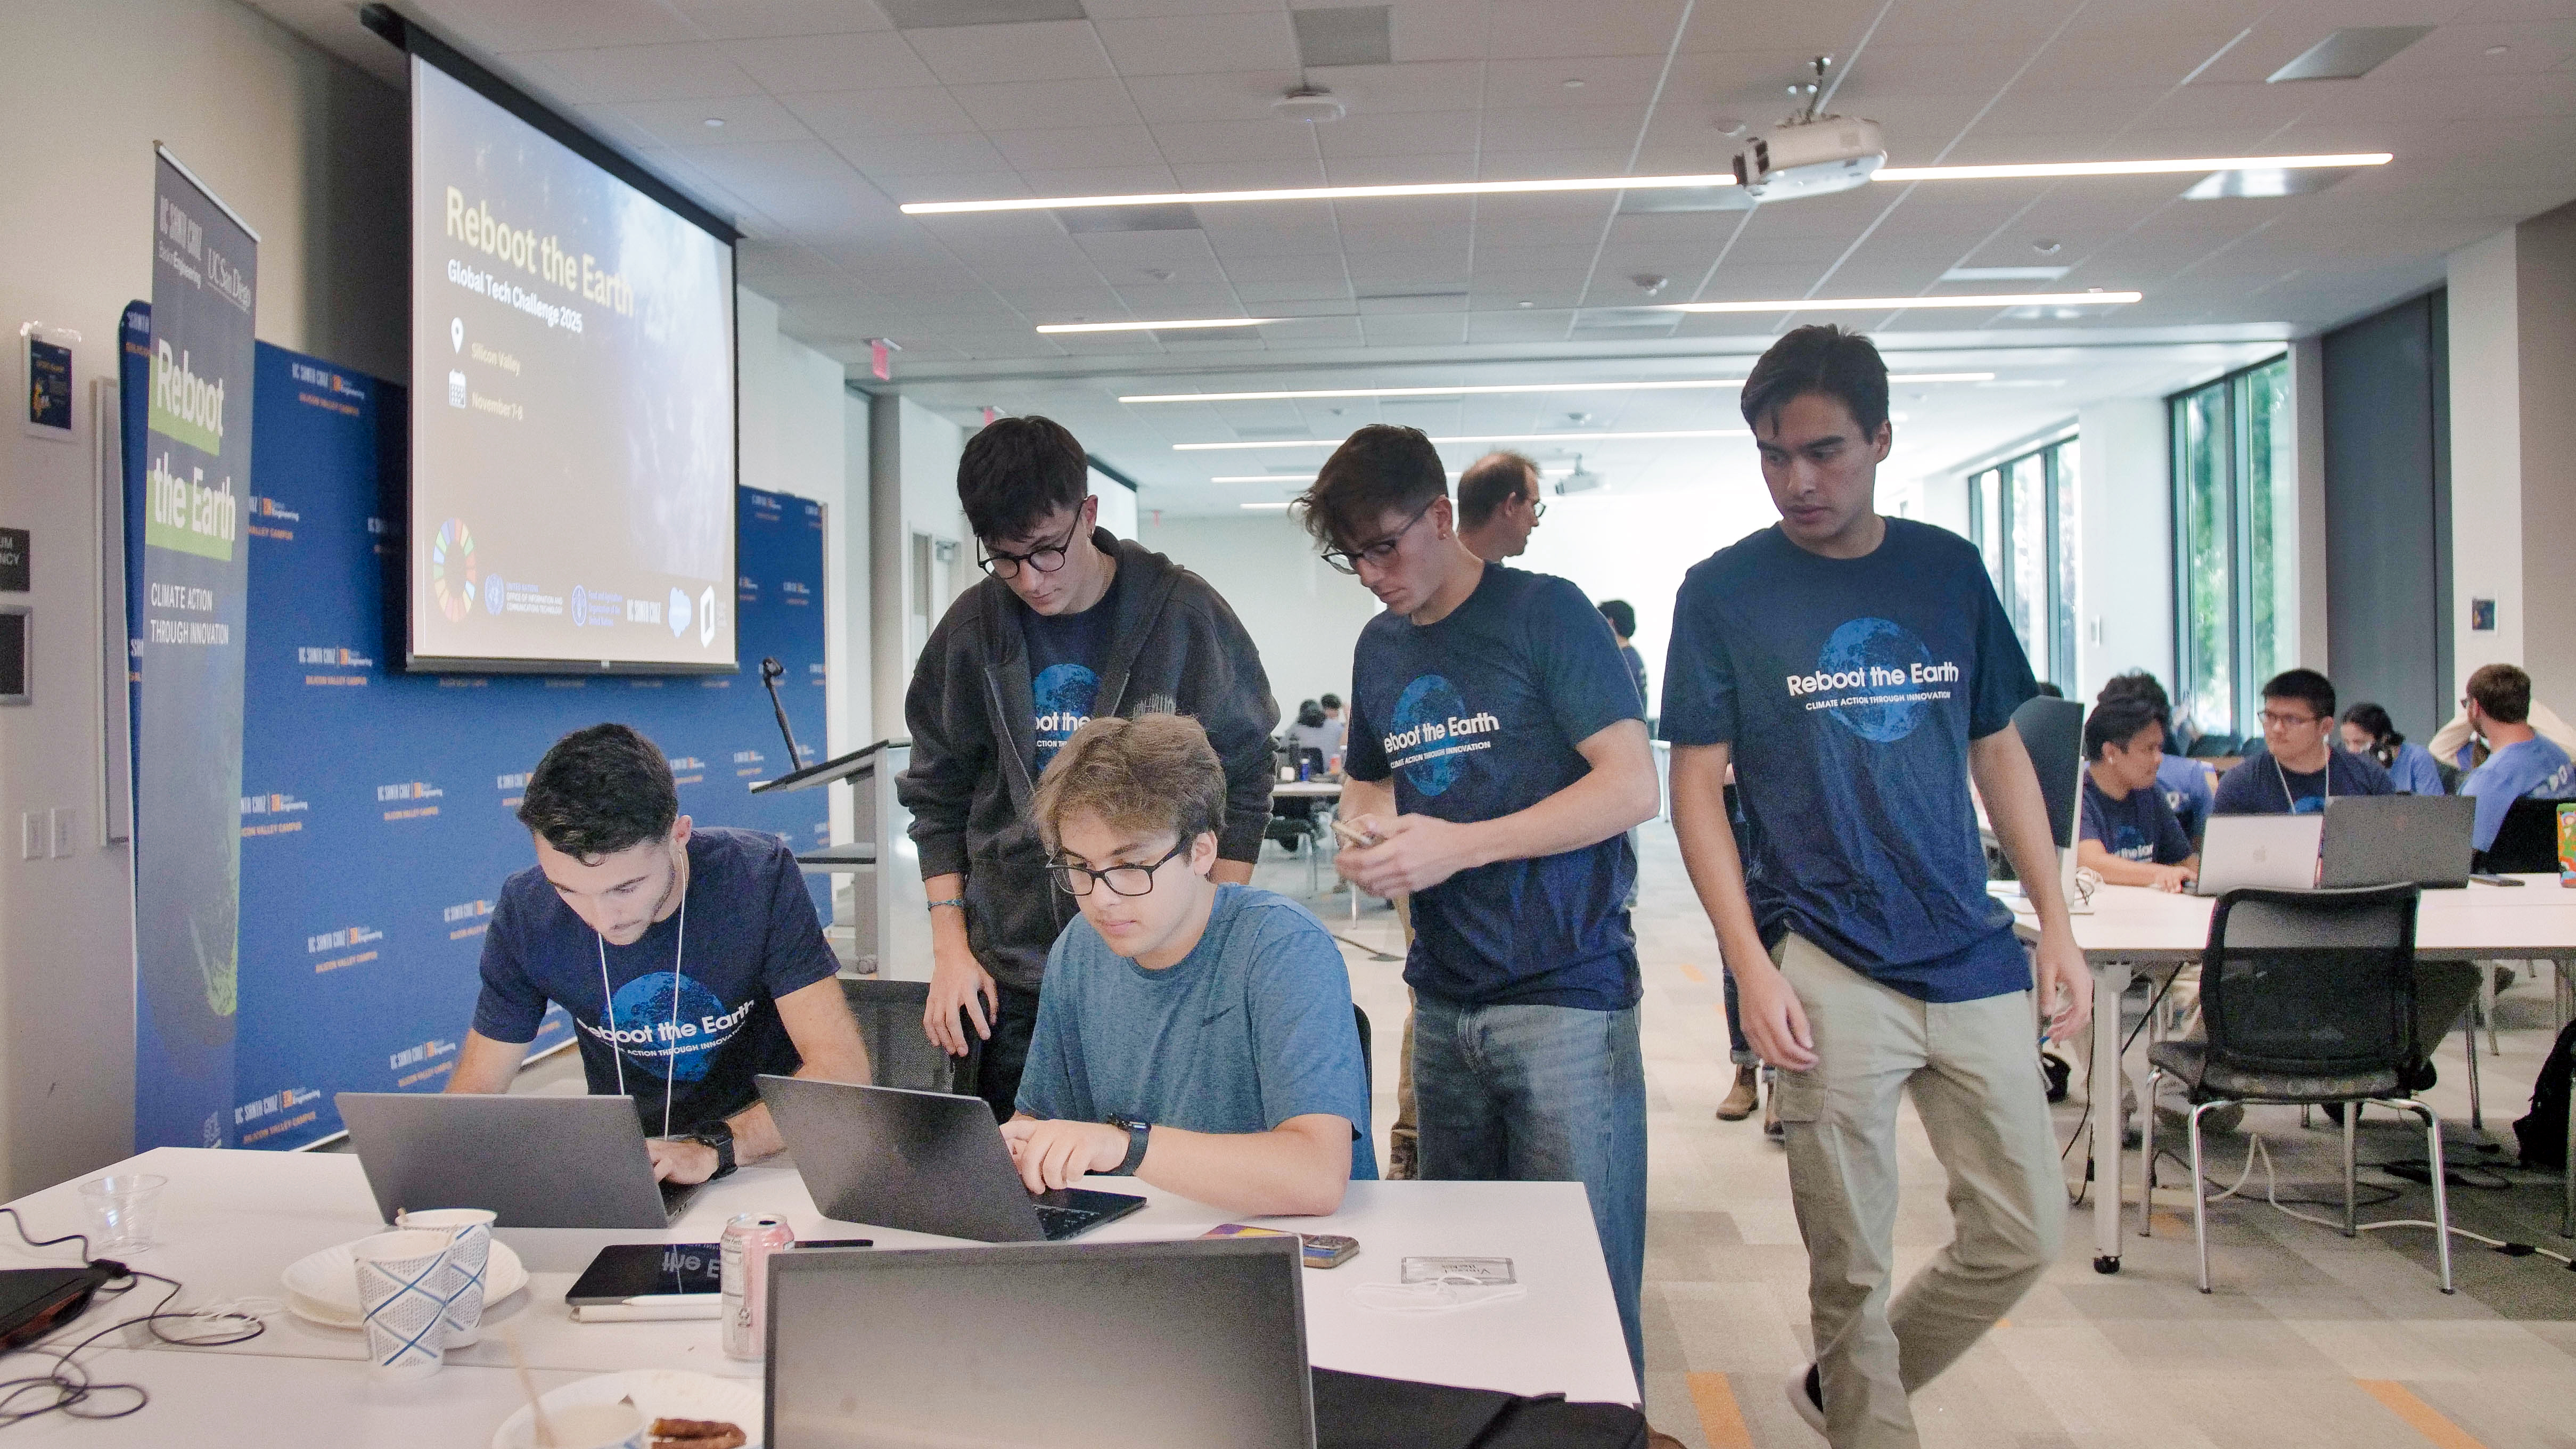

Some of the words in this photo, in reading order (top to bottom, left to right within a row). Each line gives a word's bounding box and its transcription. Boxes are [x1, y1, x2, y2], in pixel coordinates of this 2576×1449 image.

[447, 185, 537, 274] Reboot
[541, 235, 577, 291] the
[583, 253, 634, 317] Earth
[448, 259, 484, 293] Global
[485, 274, 510, 304] Tech
[513, 285, 559, 328] Challenge
[560, 306, 583, 334] 2025
[472, 341, 498, 367] Silicon
[498, 349, 521, 377] Valley
[157, 339, 224, 437] Reboot
[472, 391, 511, 419] November
[154, 451, 186, 528] the
[193, 466, 236, 542] Earth
[151, 582, 186, 609] CLIMATE
[187, 587, 213, 612] ACTION
[150, 619, 189, 644] THROUGH
[190, 621, 229, 645] INNOVATION
[1787, 667, 1865, 697] Reboot
[1871, 666, 1905, 686] the
[1910, 661, 1959, 684] Earth
[1806, 699, 1838, 710] CLIMATE
[1841, 697, 1868, 707] ACTION
[1869, 694, 1905, 704] THROUGH
[1906, 691, 1951, 701] INNOVATION
[1384, 725, 1421, 754] eboot
[1423, 723, 1446, 742] the
[1448, 712, 1500, 737] Earth
[1405, 754, 1424, 764] ACTION
[1423, 749, 1445, 760] THROUGH
[1446, 741, 1491, 755] INNOVATION
[658, 1021, 697, 1041] the
[658, 1044, 699, 1056] THROUGH
